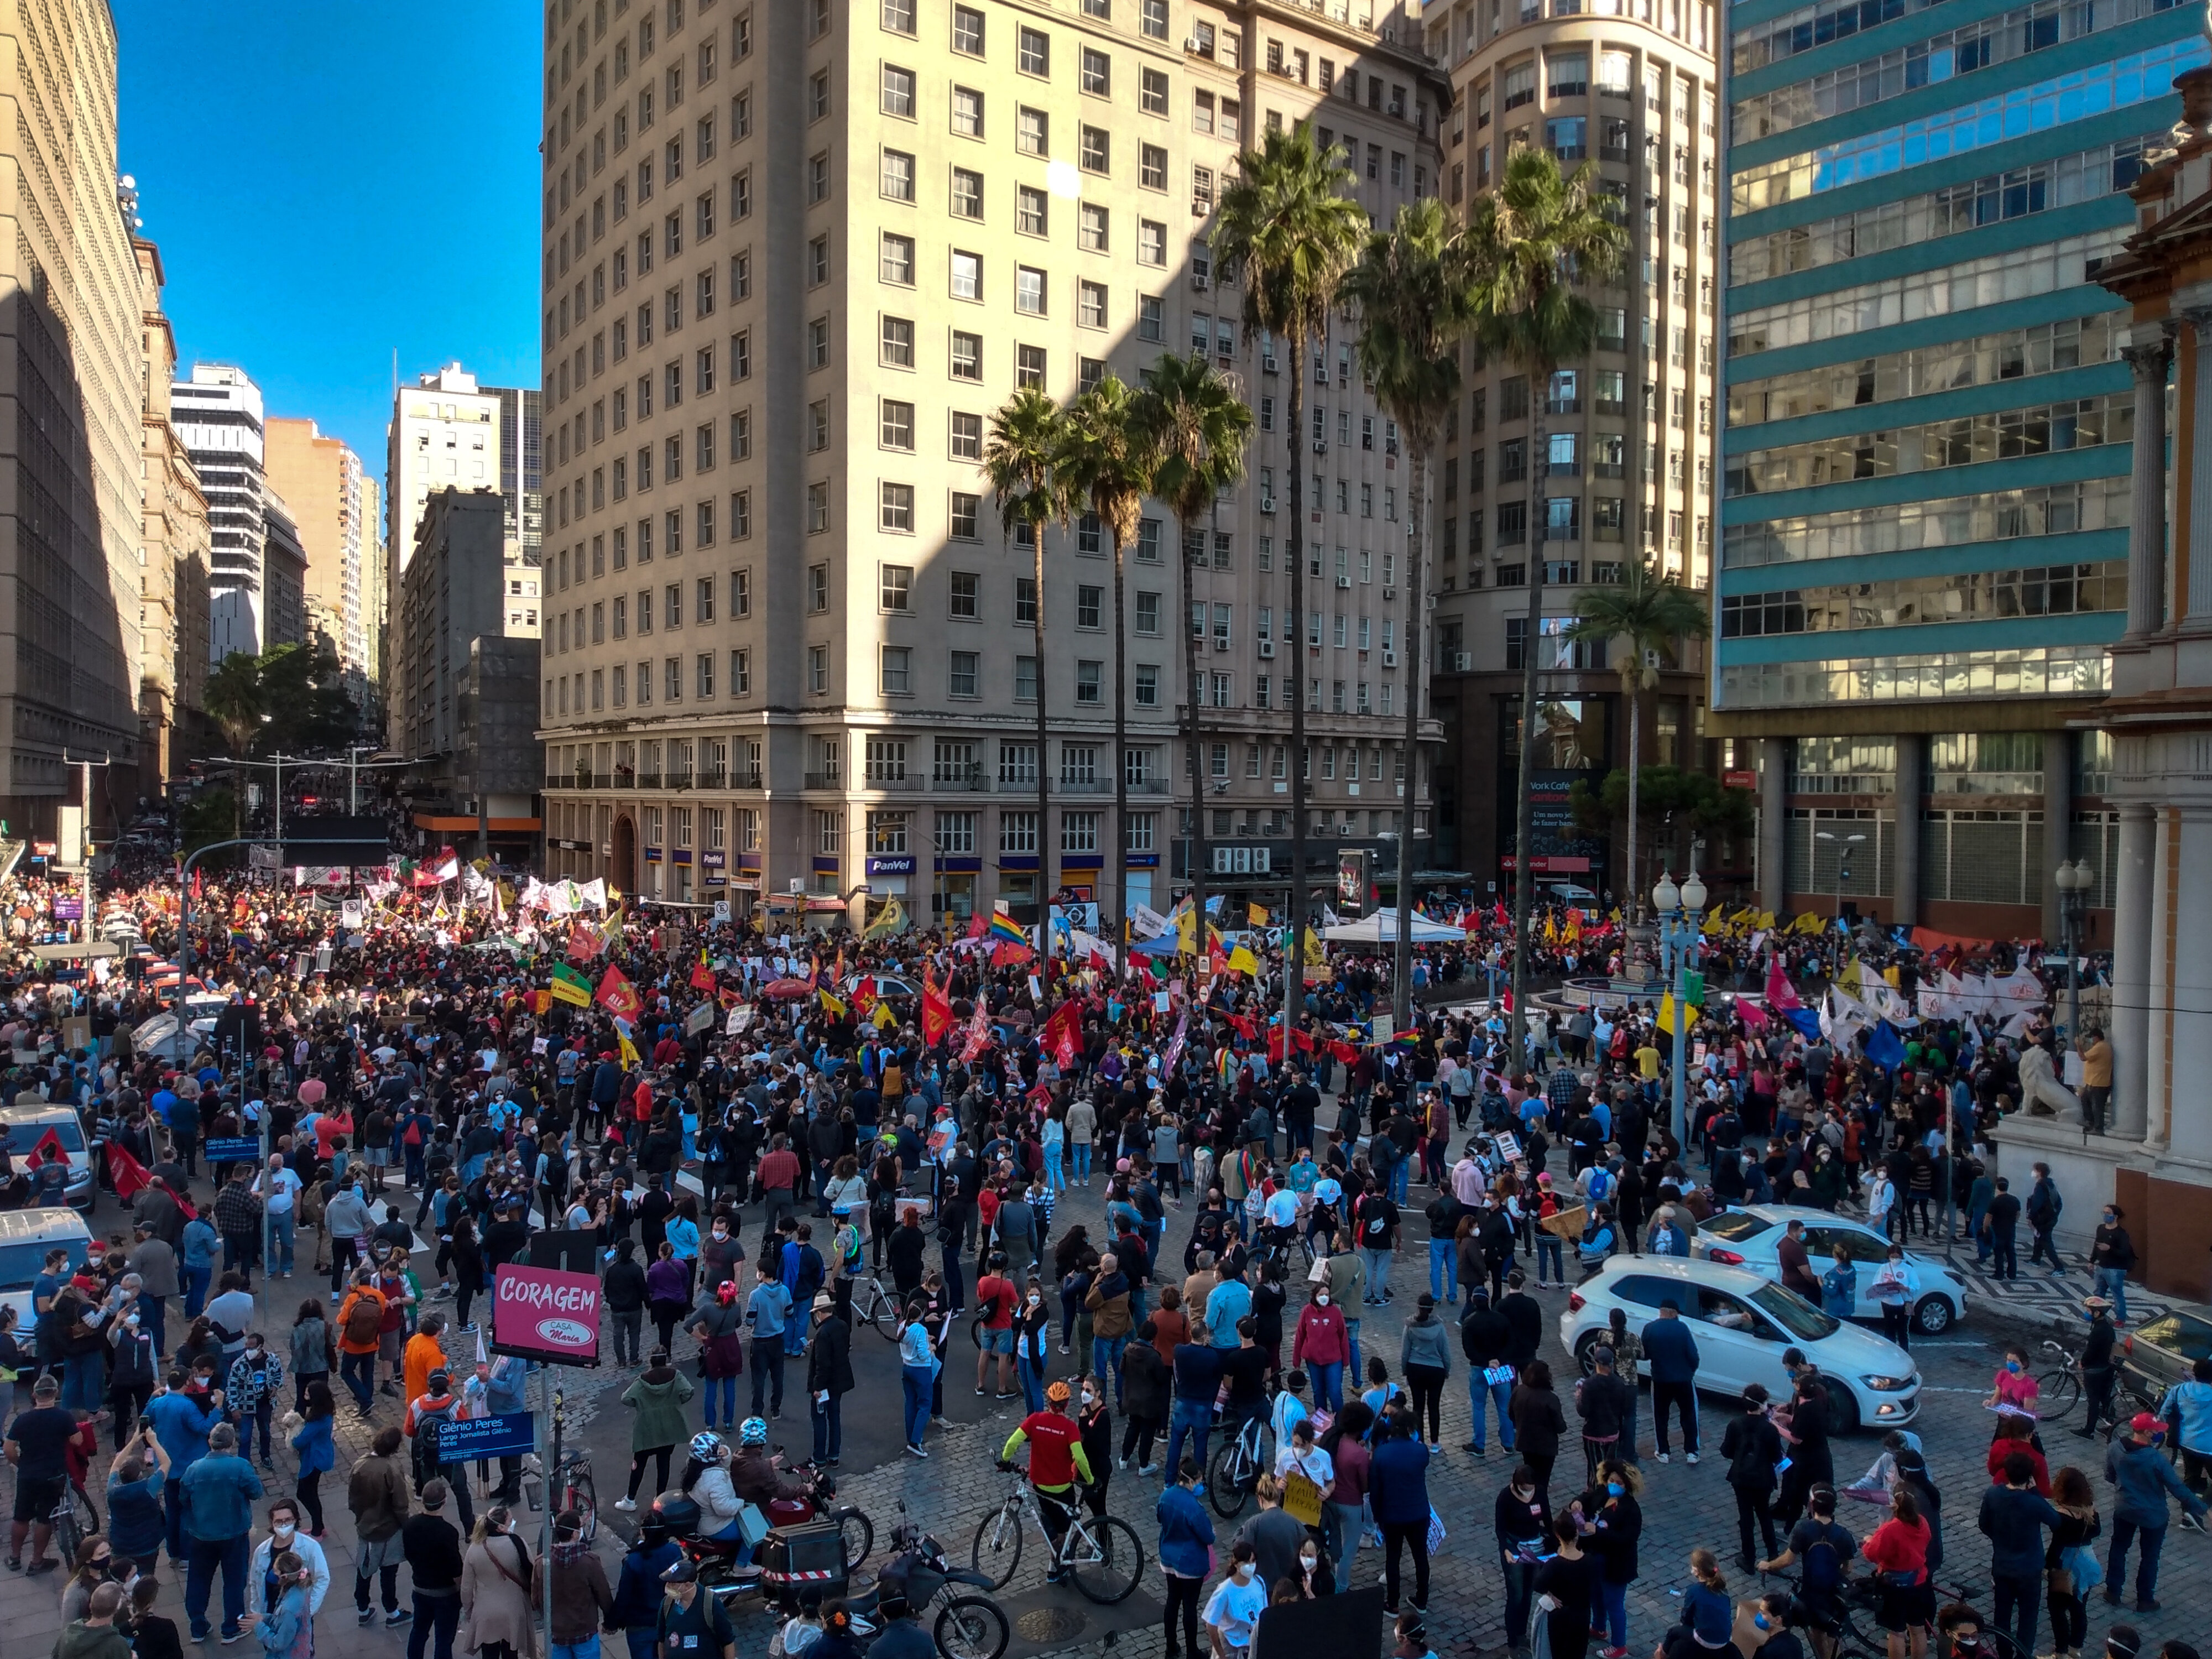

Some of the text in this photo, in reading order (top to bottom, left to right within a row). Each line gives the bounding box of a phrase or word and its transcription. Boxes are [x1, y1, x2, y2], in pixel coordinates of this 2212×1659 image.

[1551, 781, 1570, 790] Café
[704, 854, 722, 864] PanVel
[873, 860, 910, 870] PanVel
[500, 1276, 596, 1316] CORAGEM
[550, 1321, 572, 1331] CASA
[549, 1329, 581, 1343] Maria
[439, 1418, 503, 1433] Glênio Peres
[460, 1430, 490, 1439] Jornalista
